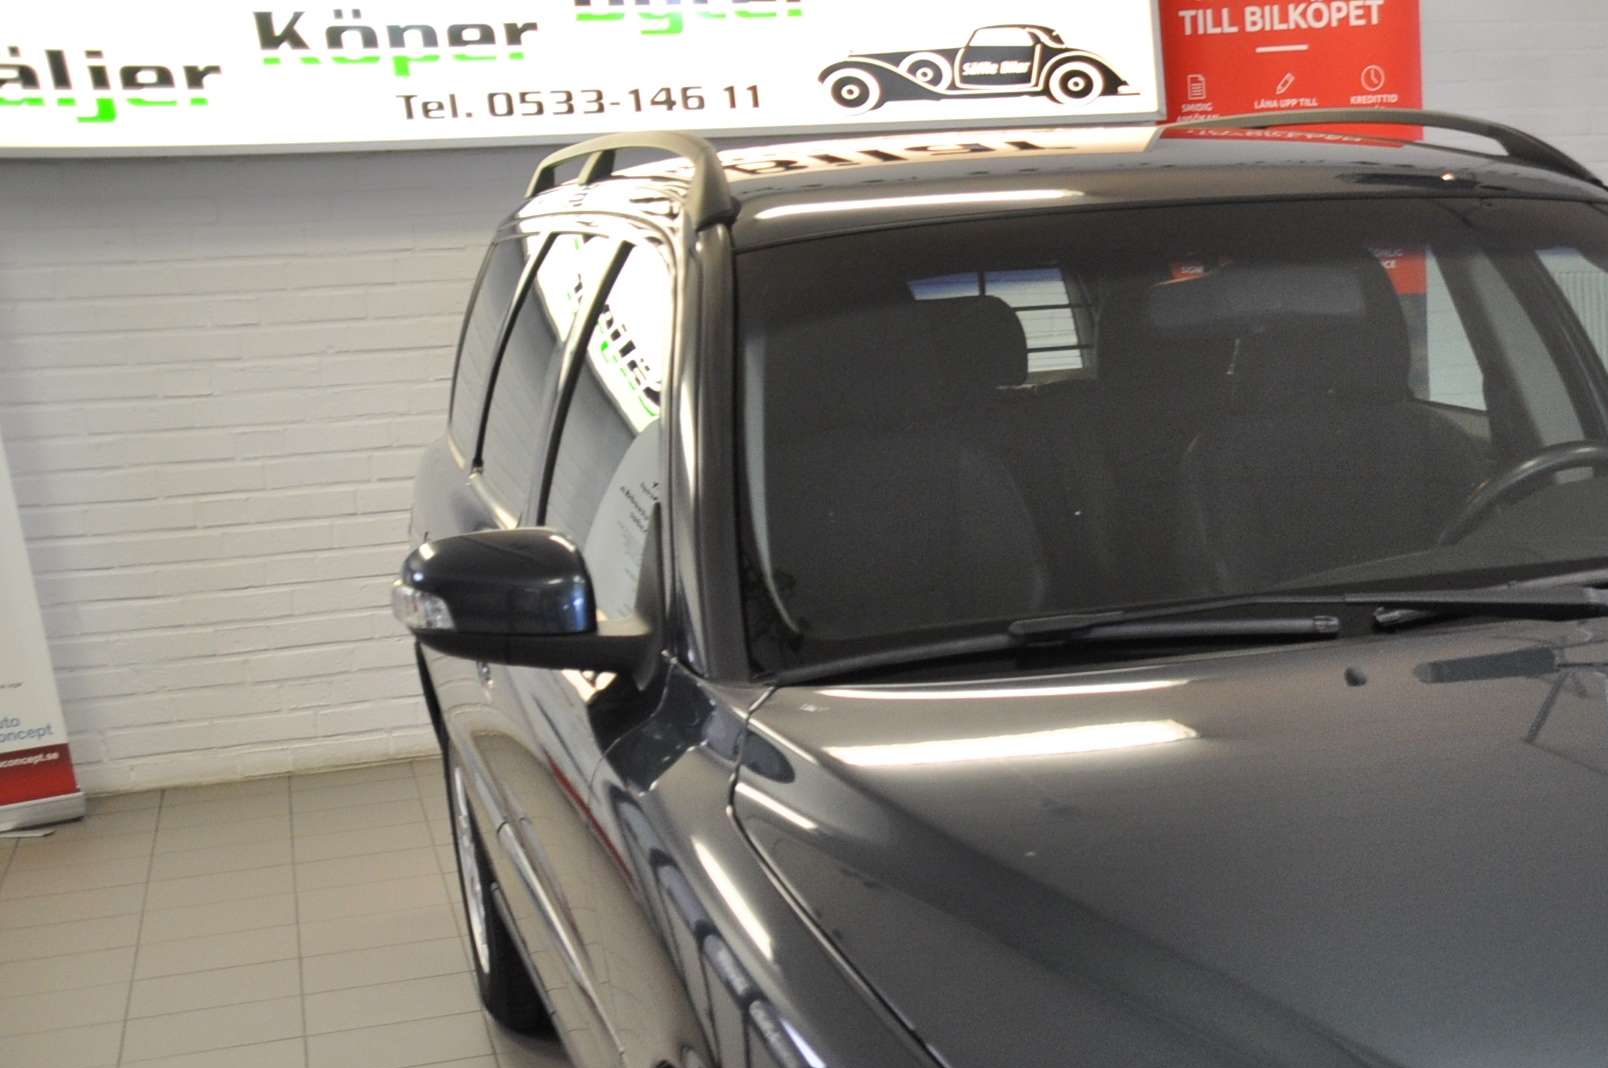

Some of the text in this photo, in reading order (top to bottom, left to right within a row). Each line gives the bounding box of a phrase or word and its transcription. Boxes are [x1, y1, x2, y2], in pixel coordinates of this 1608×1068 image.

[1178, 8, 1239, 35] TILL
[252, 8, 539, 77] Köper
[395, 84, 760, 120] Tel. 0533-146 11
[1299, 97, 1318, 107] TILL
